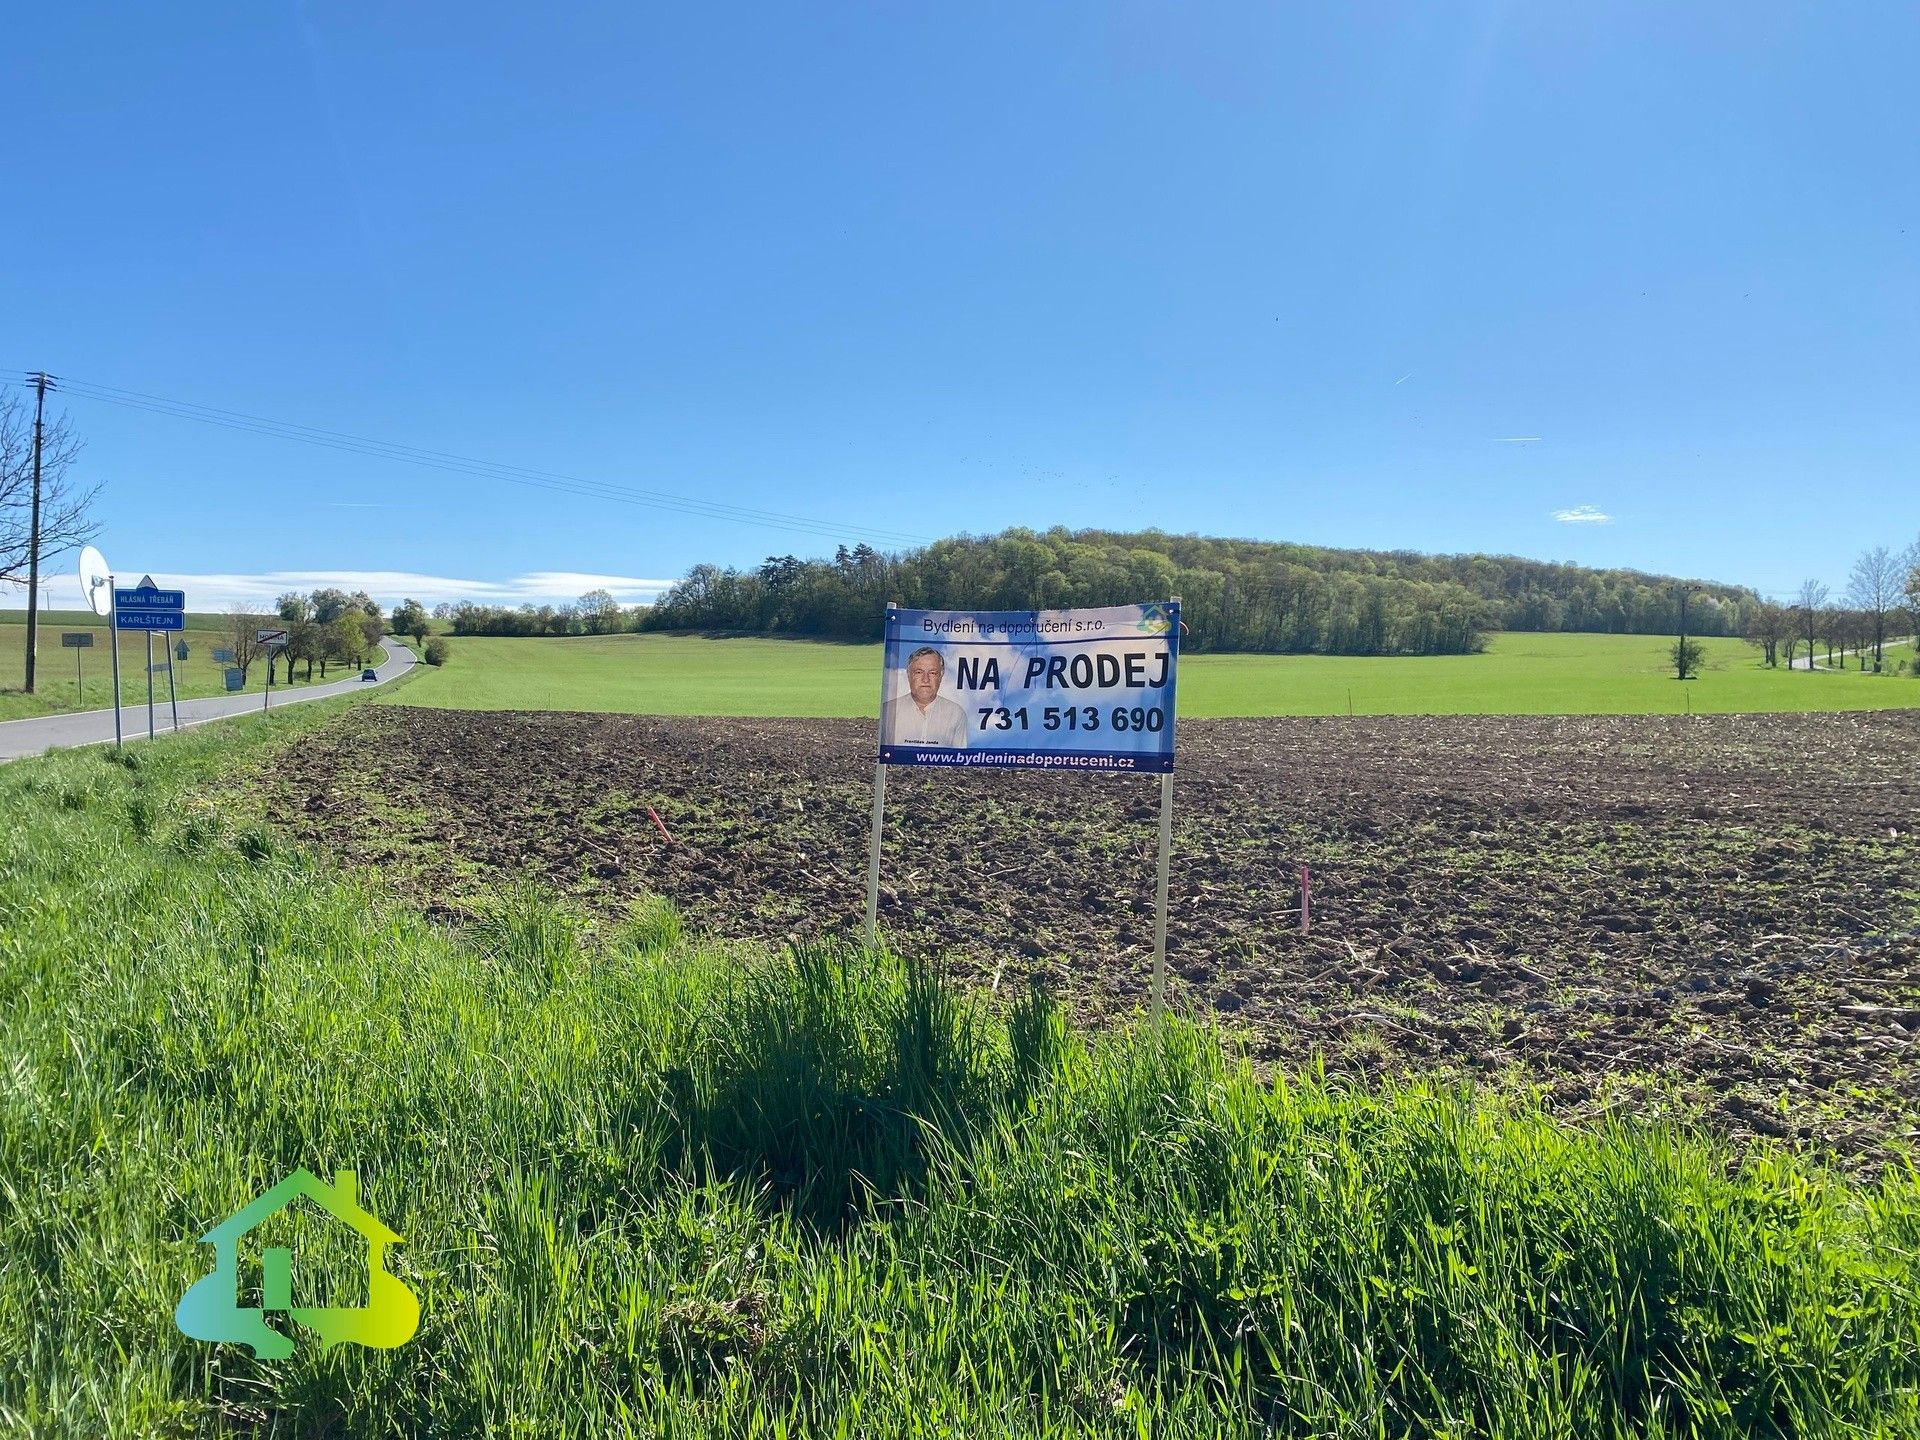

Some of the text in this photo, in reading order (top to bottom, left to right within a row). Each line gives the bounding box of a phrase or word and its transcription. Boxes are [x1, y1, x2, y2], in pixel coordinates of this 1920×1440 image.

[120, 615, 174, 625] KARLŠTEJN
[923, 618, 1106, 637] Bydlení na doporučení s.r.o.
[957, 653, 1169, 690] NA PRODEJ
[978, 707, 1164, 732] 731 513 690
[916, 752, 1135, 769] www.bydleninadoporuceni.cz
